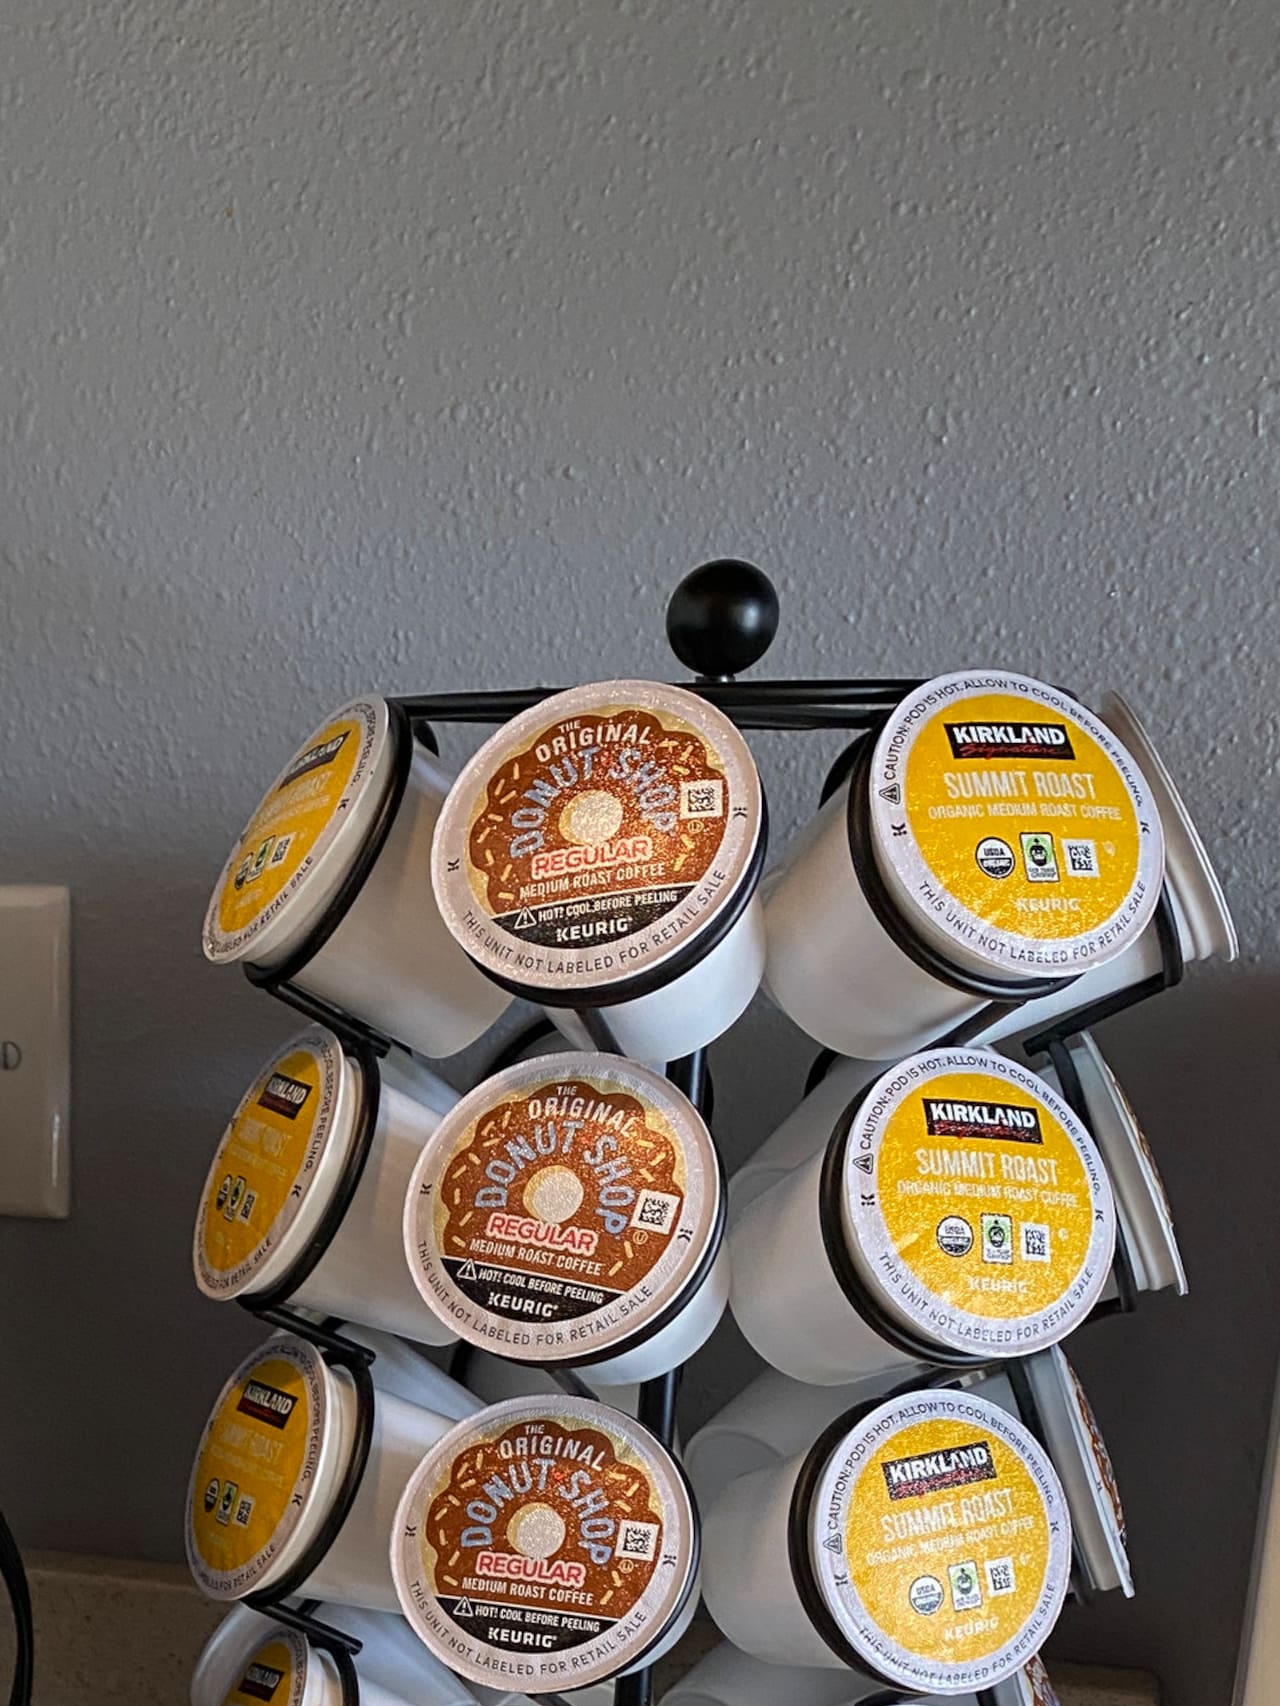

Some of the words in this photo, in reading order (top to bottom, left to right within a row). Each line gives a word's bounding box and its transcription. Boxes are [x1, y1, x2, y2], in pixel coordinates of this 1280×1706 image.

[904, 702, 927, 726] POD
[925, 694, 937, 705] IS
[965, 679, 1008, 689] ALLOW
[1010, 681, 1029, 693] TO
[1032, 687, 1069, 712] COOL
[1070, 706, 1112, 750] BEFORE
[537, 722, 650, 763] ORIGINAL
[952, 727, 1064, 745] KIRKLAND
[511, 747, 600, 859] DONUT
[608, 750, 676, 834] SHOP
[943, 770, 1028, 799] SUMMIT
[1032, 771, 1095, 800] ROAST
[533, 842, 650, 879] REGULAR
[520, 881, 568, 900] MEDIUM
[572, 872, 613, 892] ROAST
[616, 863, 667, 885] COFFEE
[463, 904, 486, 933] THIS
[485, 932, 514, 955] UNIT
[515, 951, 544, 968] NOT
[548, 955, 616, 972] LABELED
[622, 939, 653, 962] FOR
[654, 904, 703, 944] RETAIL
[699, 866, 728, 901] SALE
[538, 908, 563, 923] HOT!
[565, 903, 592, 918] COOL
[594, 897, 633, 913] BEFORE
[635, 889, 679, 907] PEELING
[919, 880, 946, 911] THIS
[946, 912, 977, 939] UNIT
[978, 934, 1006, 954] NOT
[1010, 946, 1068, 963] LABELED
[1073, 943, 1097, 959] FOR
[1099, 914, 1132, 949] RETAIL
[1128, 880, 1146, 914] SALE
[557, 1084, 579, 1096] THE
[530, 1096, 635, 1138] ORIGINAL
[930, 1102, 1036, 1128] KIRKLAND
[475, 1121, 585, 1208] DONUT
[583, 1135, 635, 1236] SHOP
[915, 1146, 995, 1178] SUMMIT
[1000, 1152, 1058, 1185] ROAST
[487, 1214, 596, 1255] REGULAR
[469, 1239, 515, 1259] MEDIUM
[516, 1248, 556, 1267] ROAST
[556, 1256, 604, 1277] COFFEE
[419, 1239, 435, 1269] THIS
[429, 1272, 451, 1300] UNIT
[448, 1299, 473, 1323] NOT
[473, 1318, 532, 1345] LABELED
[537, 1332, 565, 1345] FOR
[571, 1313, 620, 1341] RETAIL
[621, 1285, 654, 1315] SALE
[478, 1268, 503, 1283] HOT!
[502, 1274, 528, 1288] COOL
[528, 1279, 564, 1297] BEFORE
[564, 1286, 606, 1305] PEELING
[880, 1252, 904, 1284] THIS
[902, 1285, 930, 1313] UNIT
[929, 1309, 956, 1330] NOT
[958, 1323, 1011, 1343] LABELED
[1016, 1326, 1038, 1340] FOR
[1042, 1300, 1075, 1332] RETAIL
[1073, 1268, 1092, 1301] SALE
[524, 1424, 545, 1435] THE
[500, 1435, 605, 1472] ORIGINAL
[889, 1447, 987, 1482] KIRKLAND
[462, 1459, 556, 1548] DONUT
[559, 1471, 616, 1567] SHOP
[882, 1501, 956, 1542] SUMMIT
[960, 1488, 1013, 1520] ROAST
[477, 1553, 584, 1586] REGULAR
[462, 1578, 507, 1595] MEDIUM
[509, 1584, 547, 1600] ROAST
[549, 1589, 595, 1607] COFFEE
[412, 1580, 430, 1609] THIS
[427, 1612, 451, 1637] UNIT
[450, 1636, 475, 1658] NOT
[477, 1653, 536, 1676] LABELED
[542, 1660, 569, 1675] FOR
[572, 1640, 619, 1669] RETAIL
[618, 1611, 648, 1641] SALE
[475, 1605, 498, 1618] HOT!
[499, 1609, 524, 1622] COOL
[524, 1612, 560, 1627] BEFORE
[561, 1617, 601, 1633] PEELING
